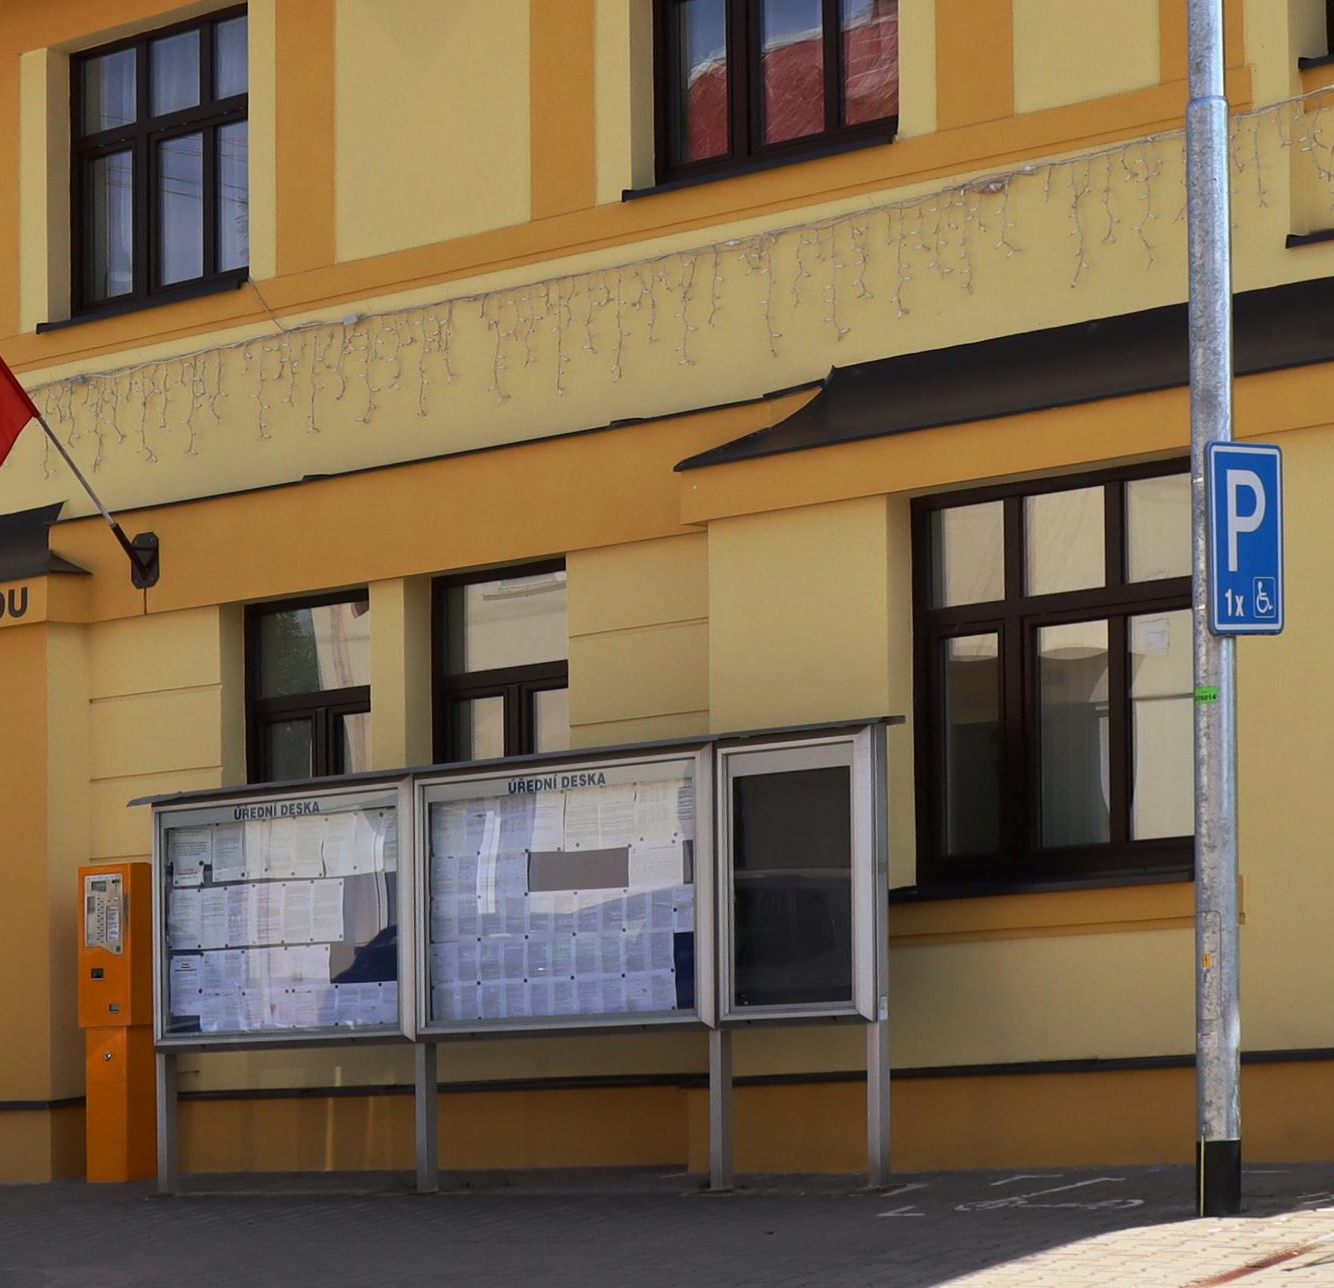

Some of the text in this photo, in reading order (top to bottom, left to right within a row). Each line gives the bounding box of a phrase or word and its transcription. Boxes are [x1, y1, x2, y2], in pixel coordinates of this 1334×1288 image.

[1226, 469, 1266, 572] P
[1225, 588, 1244, 617] 1x
[508, 772, 606, 794] ÚŘEDNÍ DESKA
[234, 801, 320, 820] ÚŘEDNÍ DESKA
